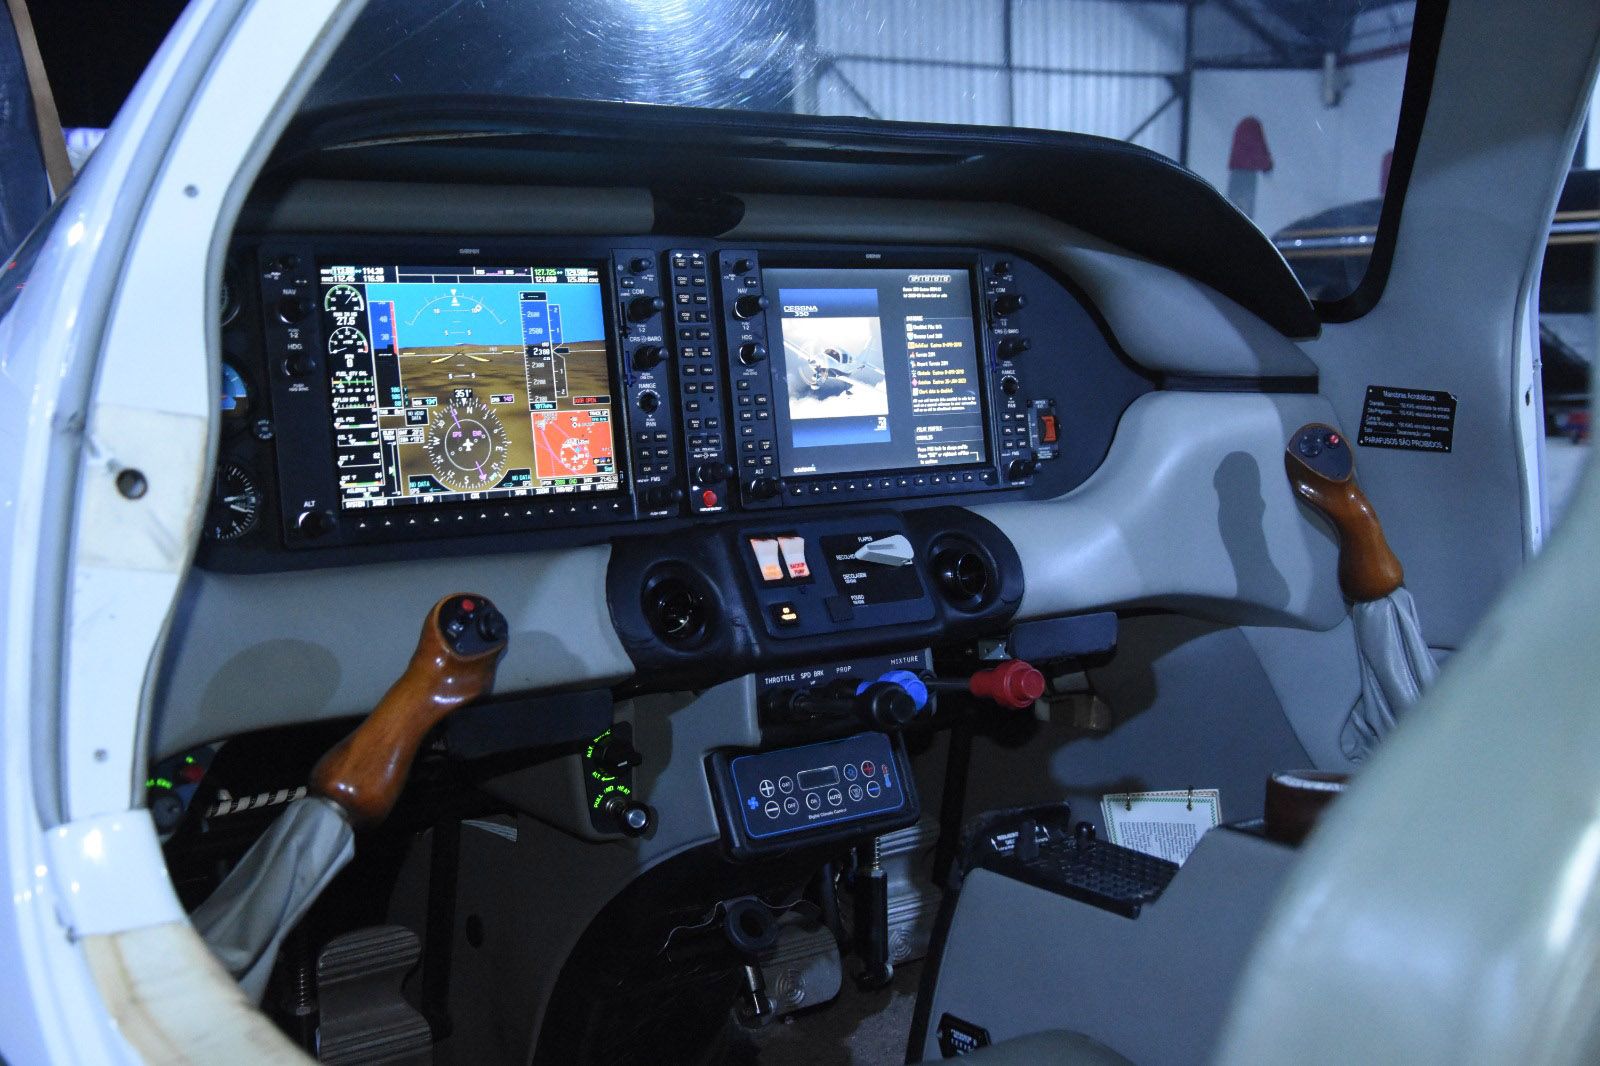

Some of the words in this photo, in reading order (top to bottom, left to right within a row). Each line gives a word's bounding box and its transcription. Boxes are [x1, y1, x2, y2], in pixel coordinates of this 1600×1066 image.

[1364, 436, 1398, 445] PARAFUSOS
[1399, 438, 1410, 446] SÃO
[890, 656, 918, 665] MIXTURE
[836, 666, 852, 674] PROP
[765, 674, 795, 684] THROTTLE
[593, 795, 603, 808] PULL
